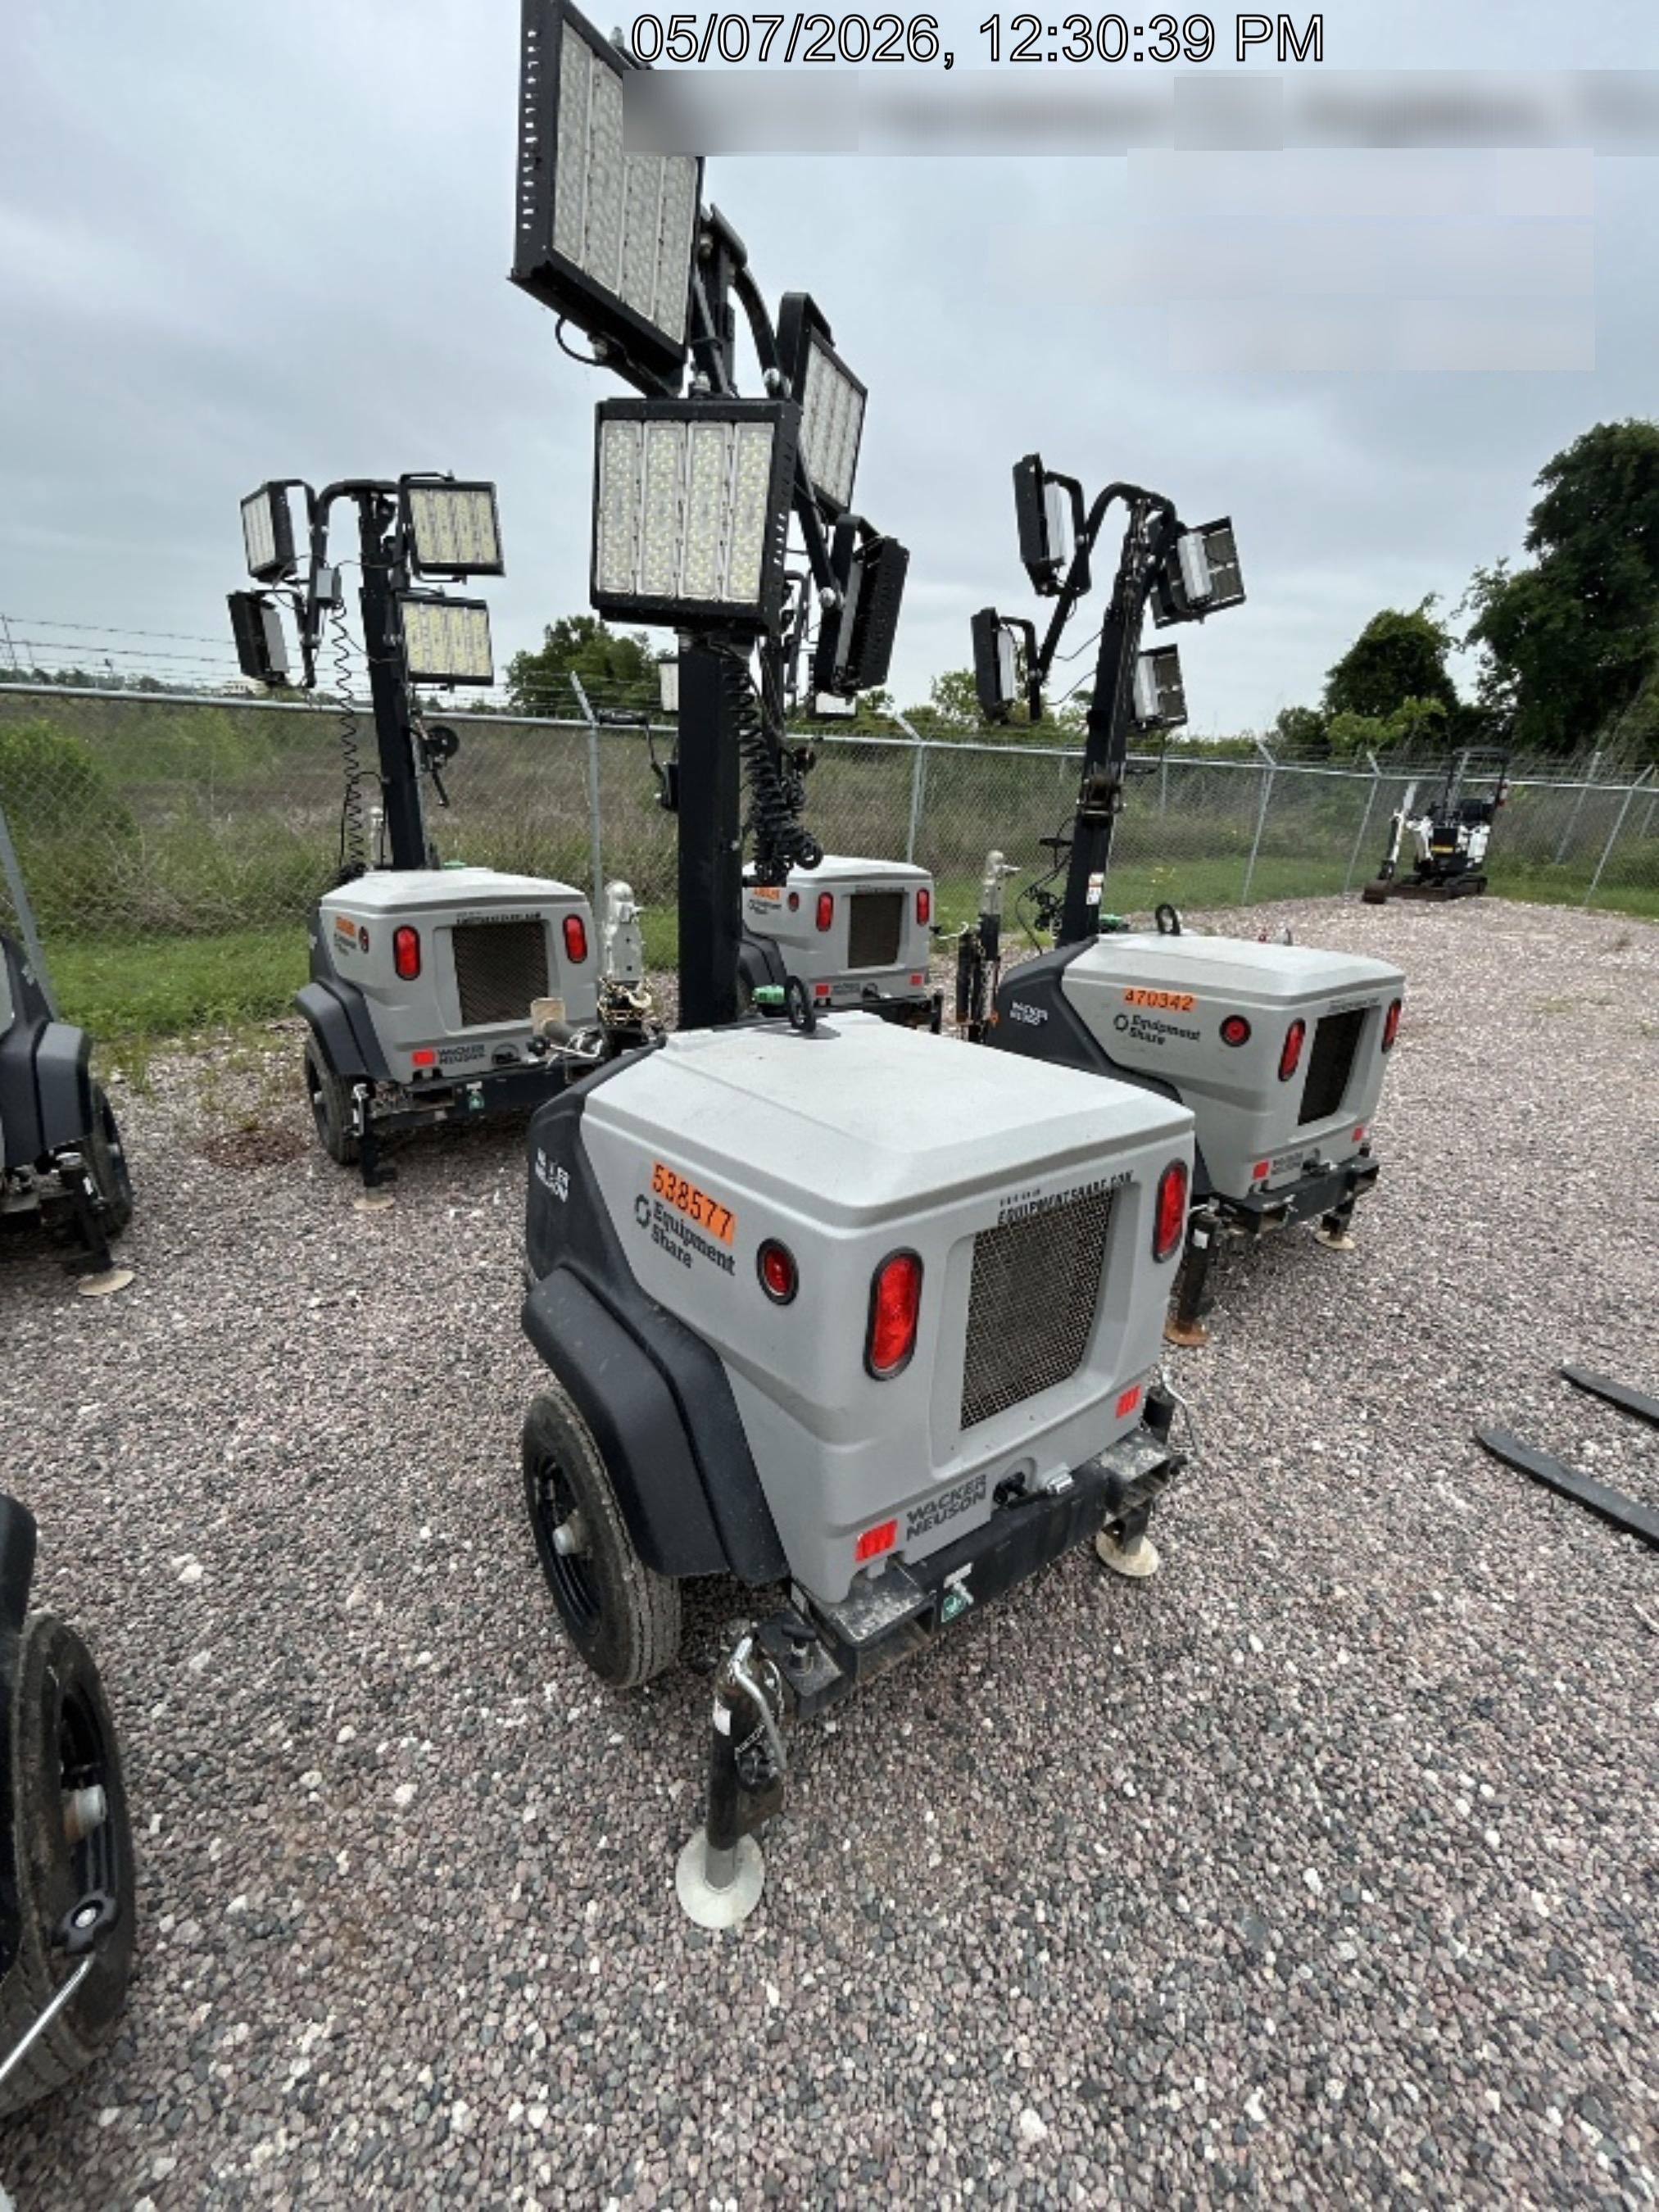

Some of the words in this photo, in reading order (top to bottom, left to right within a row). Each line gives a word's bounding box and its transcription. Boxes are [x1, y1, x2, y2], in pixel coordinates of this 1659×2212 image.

[1125, 989, 1194, 1012] 470342
[652, 1163, 734, 1241] 538577
[651, 1226, 693, 1269] Share
[652, 1201, 736, 1276] Equipment
[906, 1474, 987, 1524] WACKER
[906, 1484, 987, 1542] NEUSON
